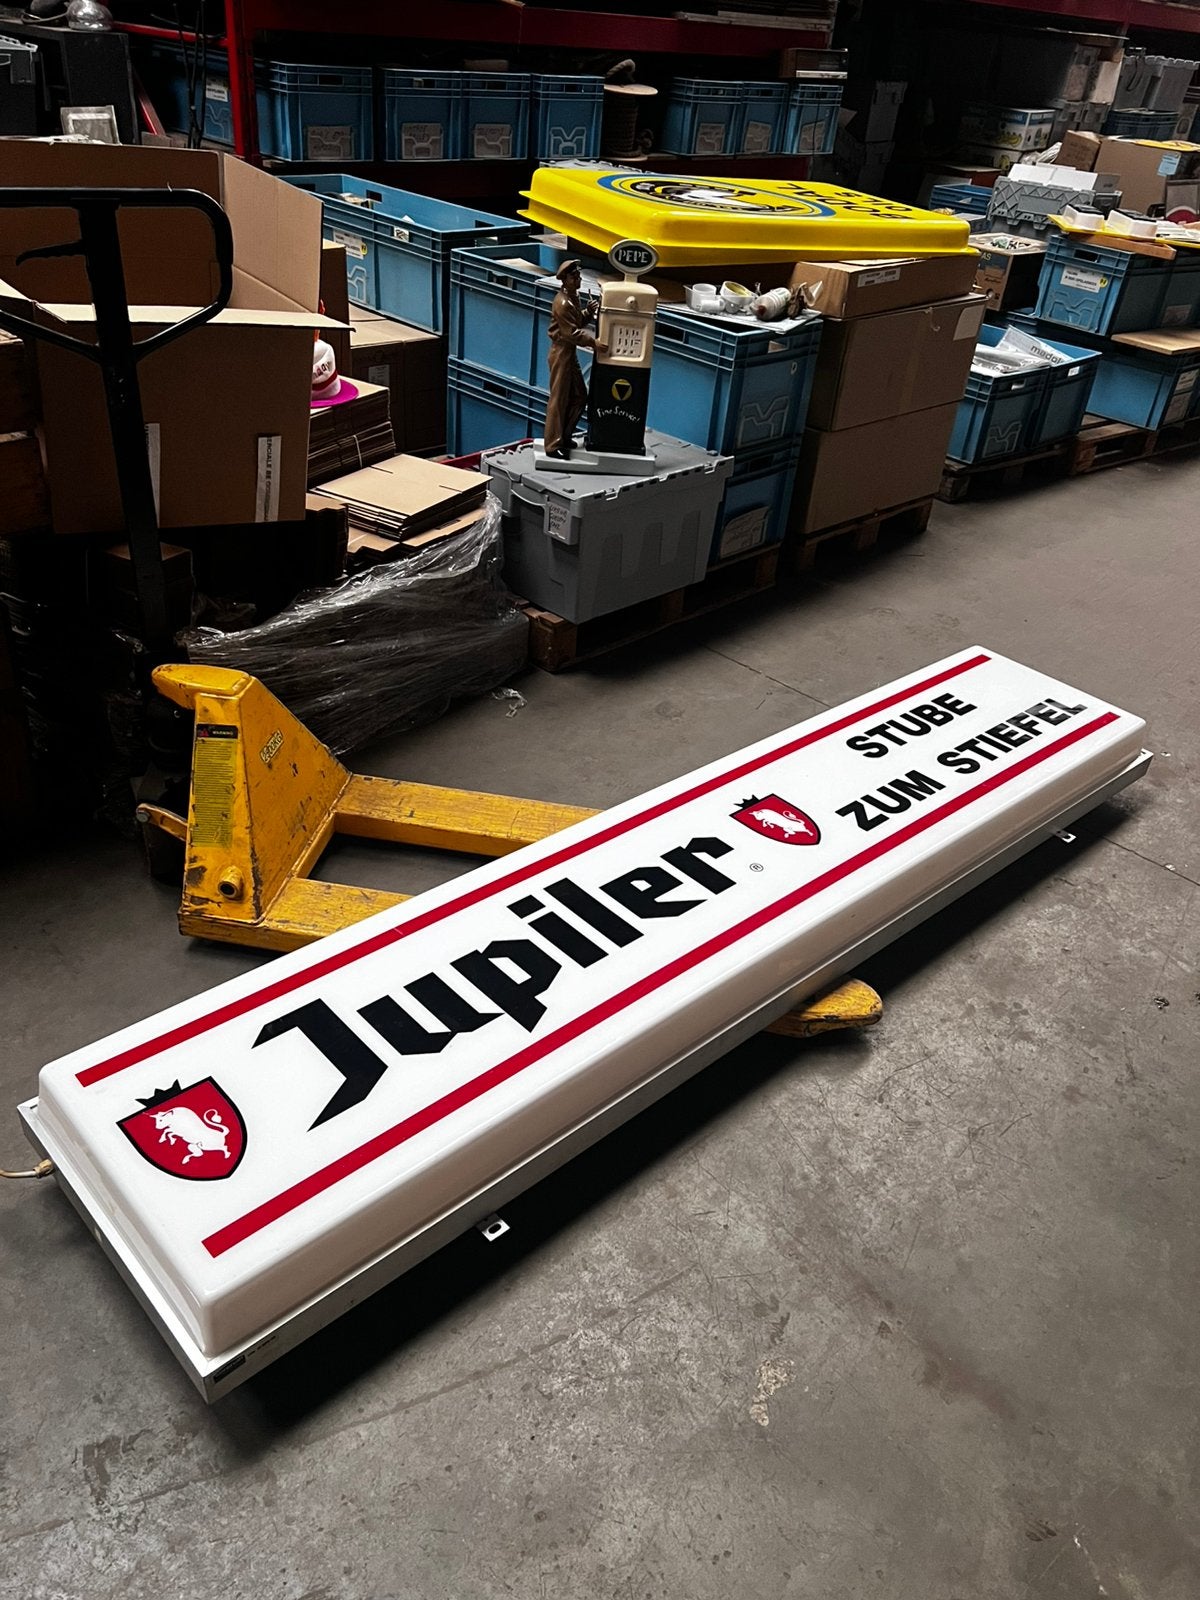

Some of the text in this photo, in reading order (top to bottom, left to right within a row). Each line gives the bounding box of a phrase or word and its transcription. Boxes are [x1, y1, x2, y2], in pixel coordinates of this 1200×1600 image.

[617, 248, 649, 263] PEPE
[835, 698, 1087, 831] ZUM STIEFEL
[846, 693, 977, 758] STUBE
[251, 837, 737, 1132] Jupiler
